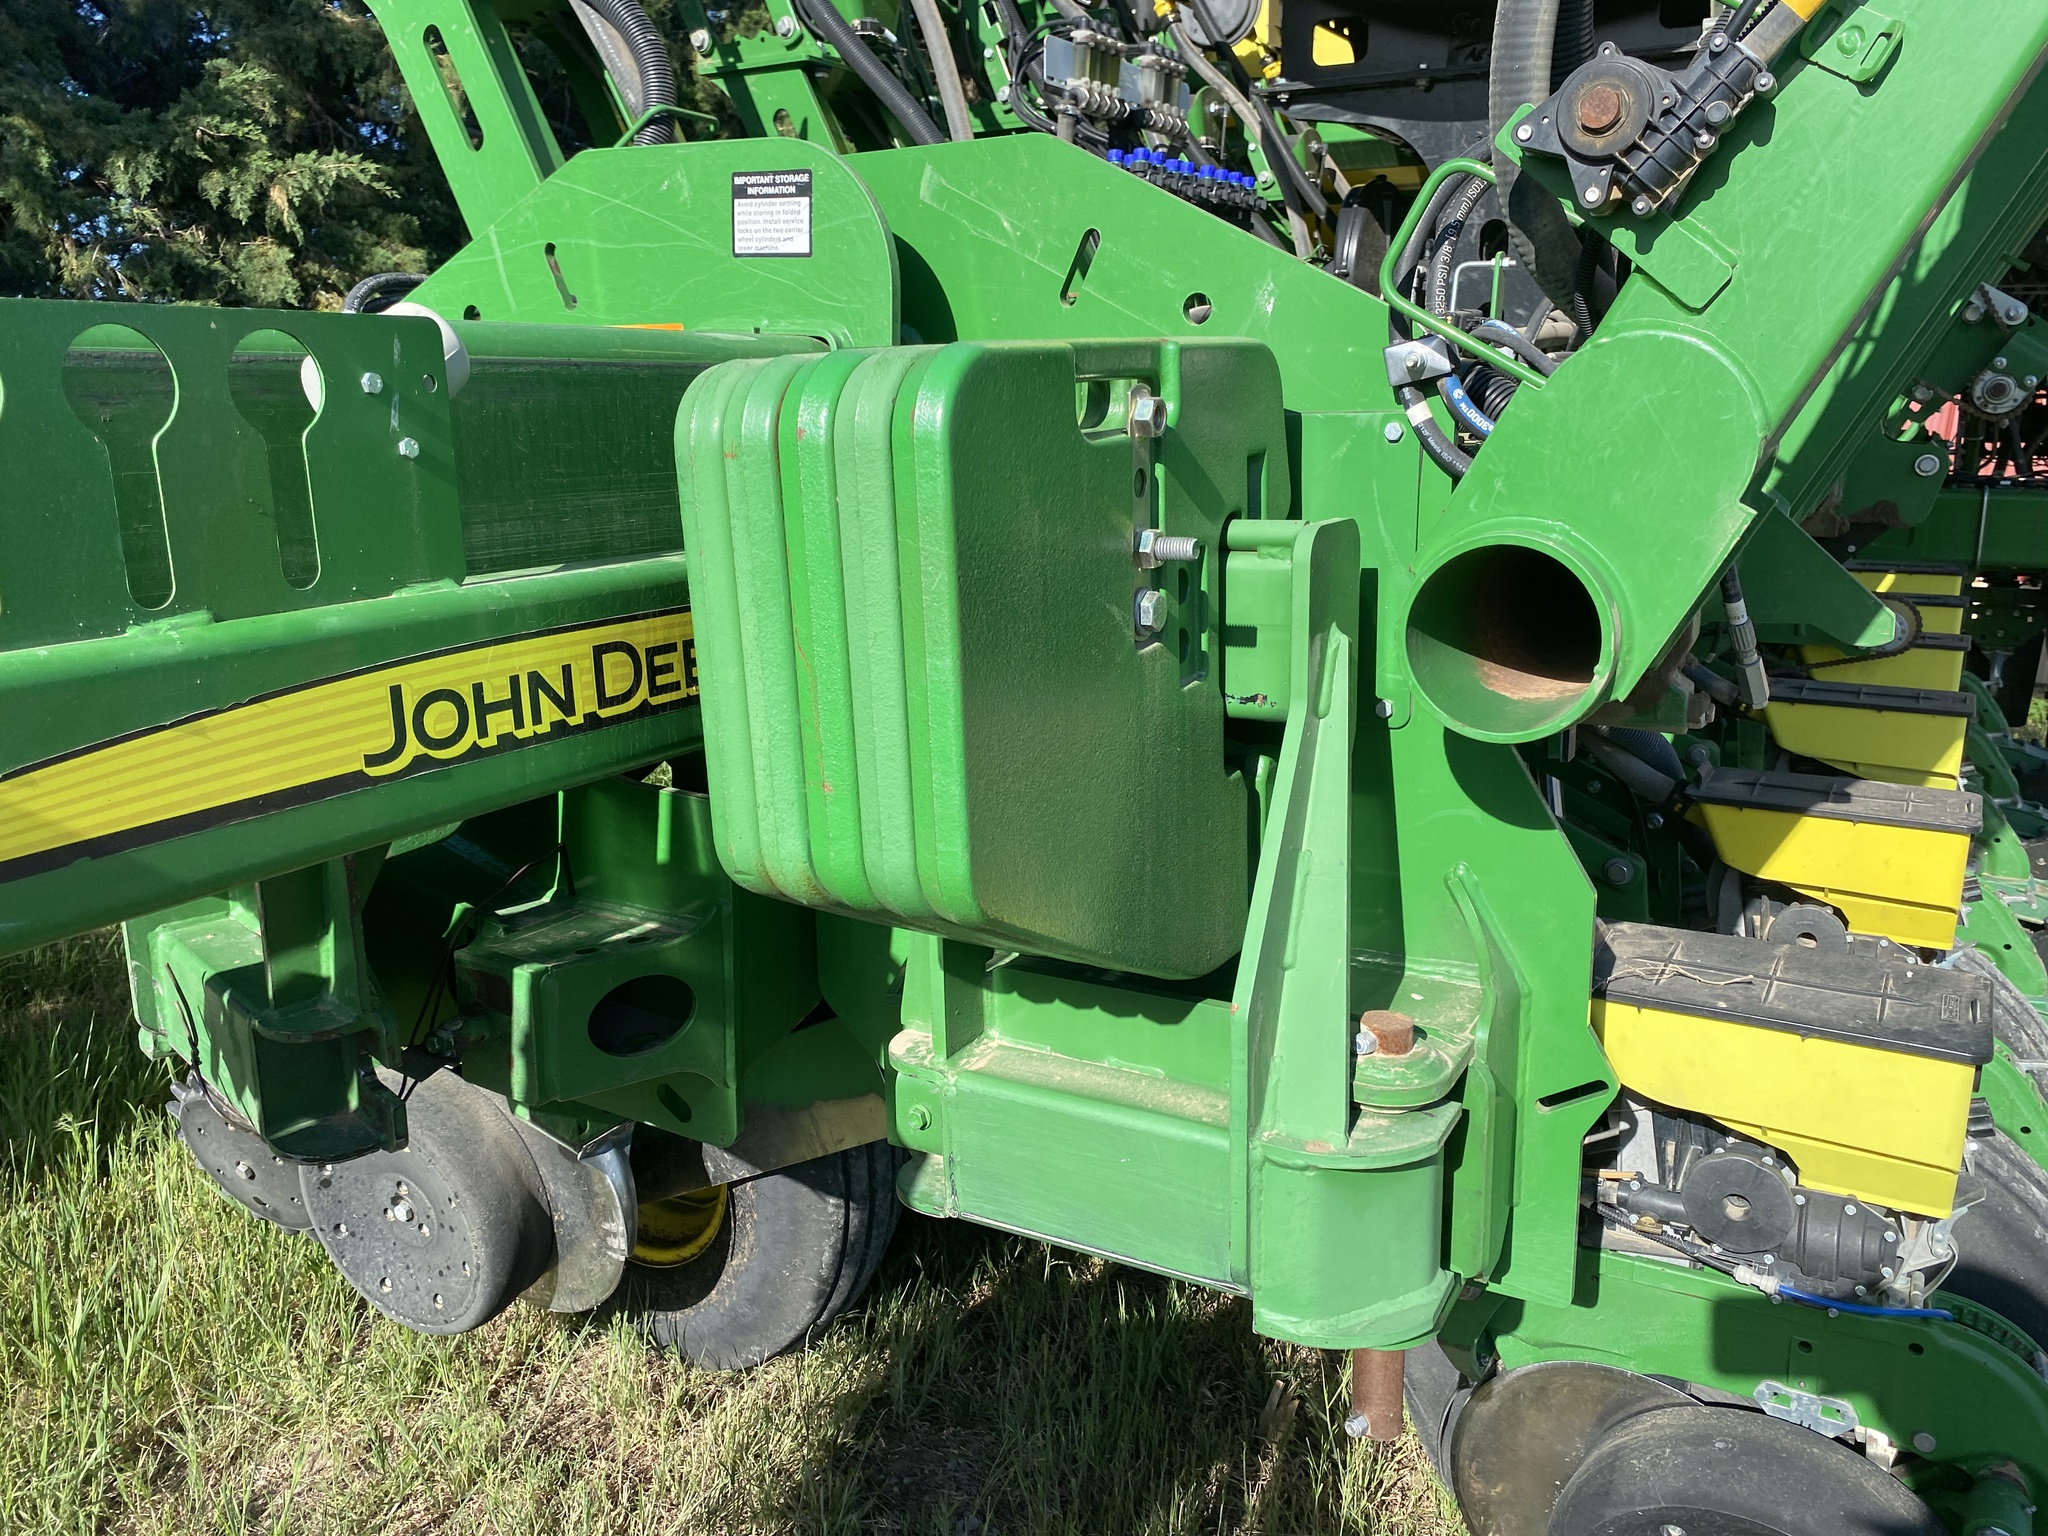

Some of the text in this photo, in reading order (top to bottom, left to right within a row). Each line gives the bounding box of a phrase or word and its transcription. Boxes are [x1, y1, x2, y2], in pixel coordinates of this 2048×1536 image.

[734, 174, 809, 185] IMPORTANT STORAGE
[747, 186, 796, 195] INFORMATION
[779, 200, 801, 208] settling
[1437, 264, 1450, 286] PSI)
[1456, 197, 1472, 221] mm)
[1441, 451, 1452, 463] ISO
[363, 664, 577, 770] JOHN
